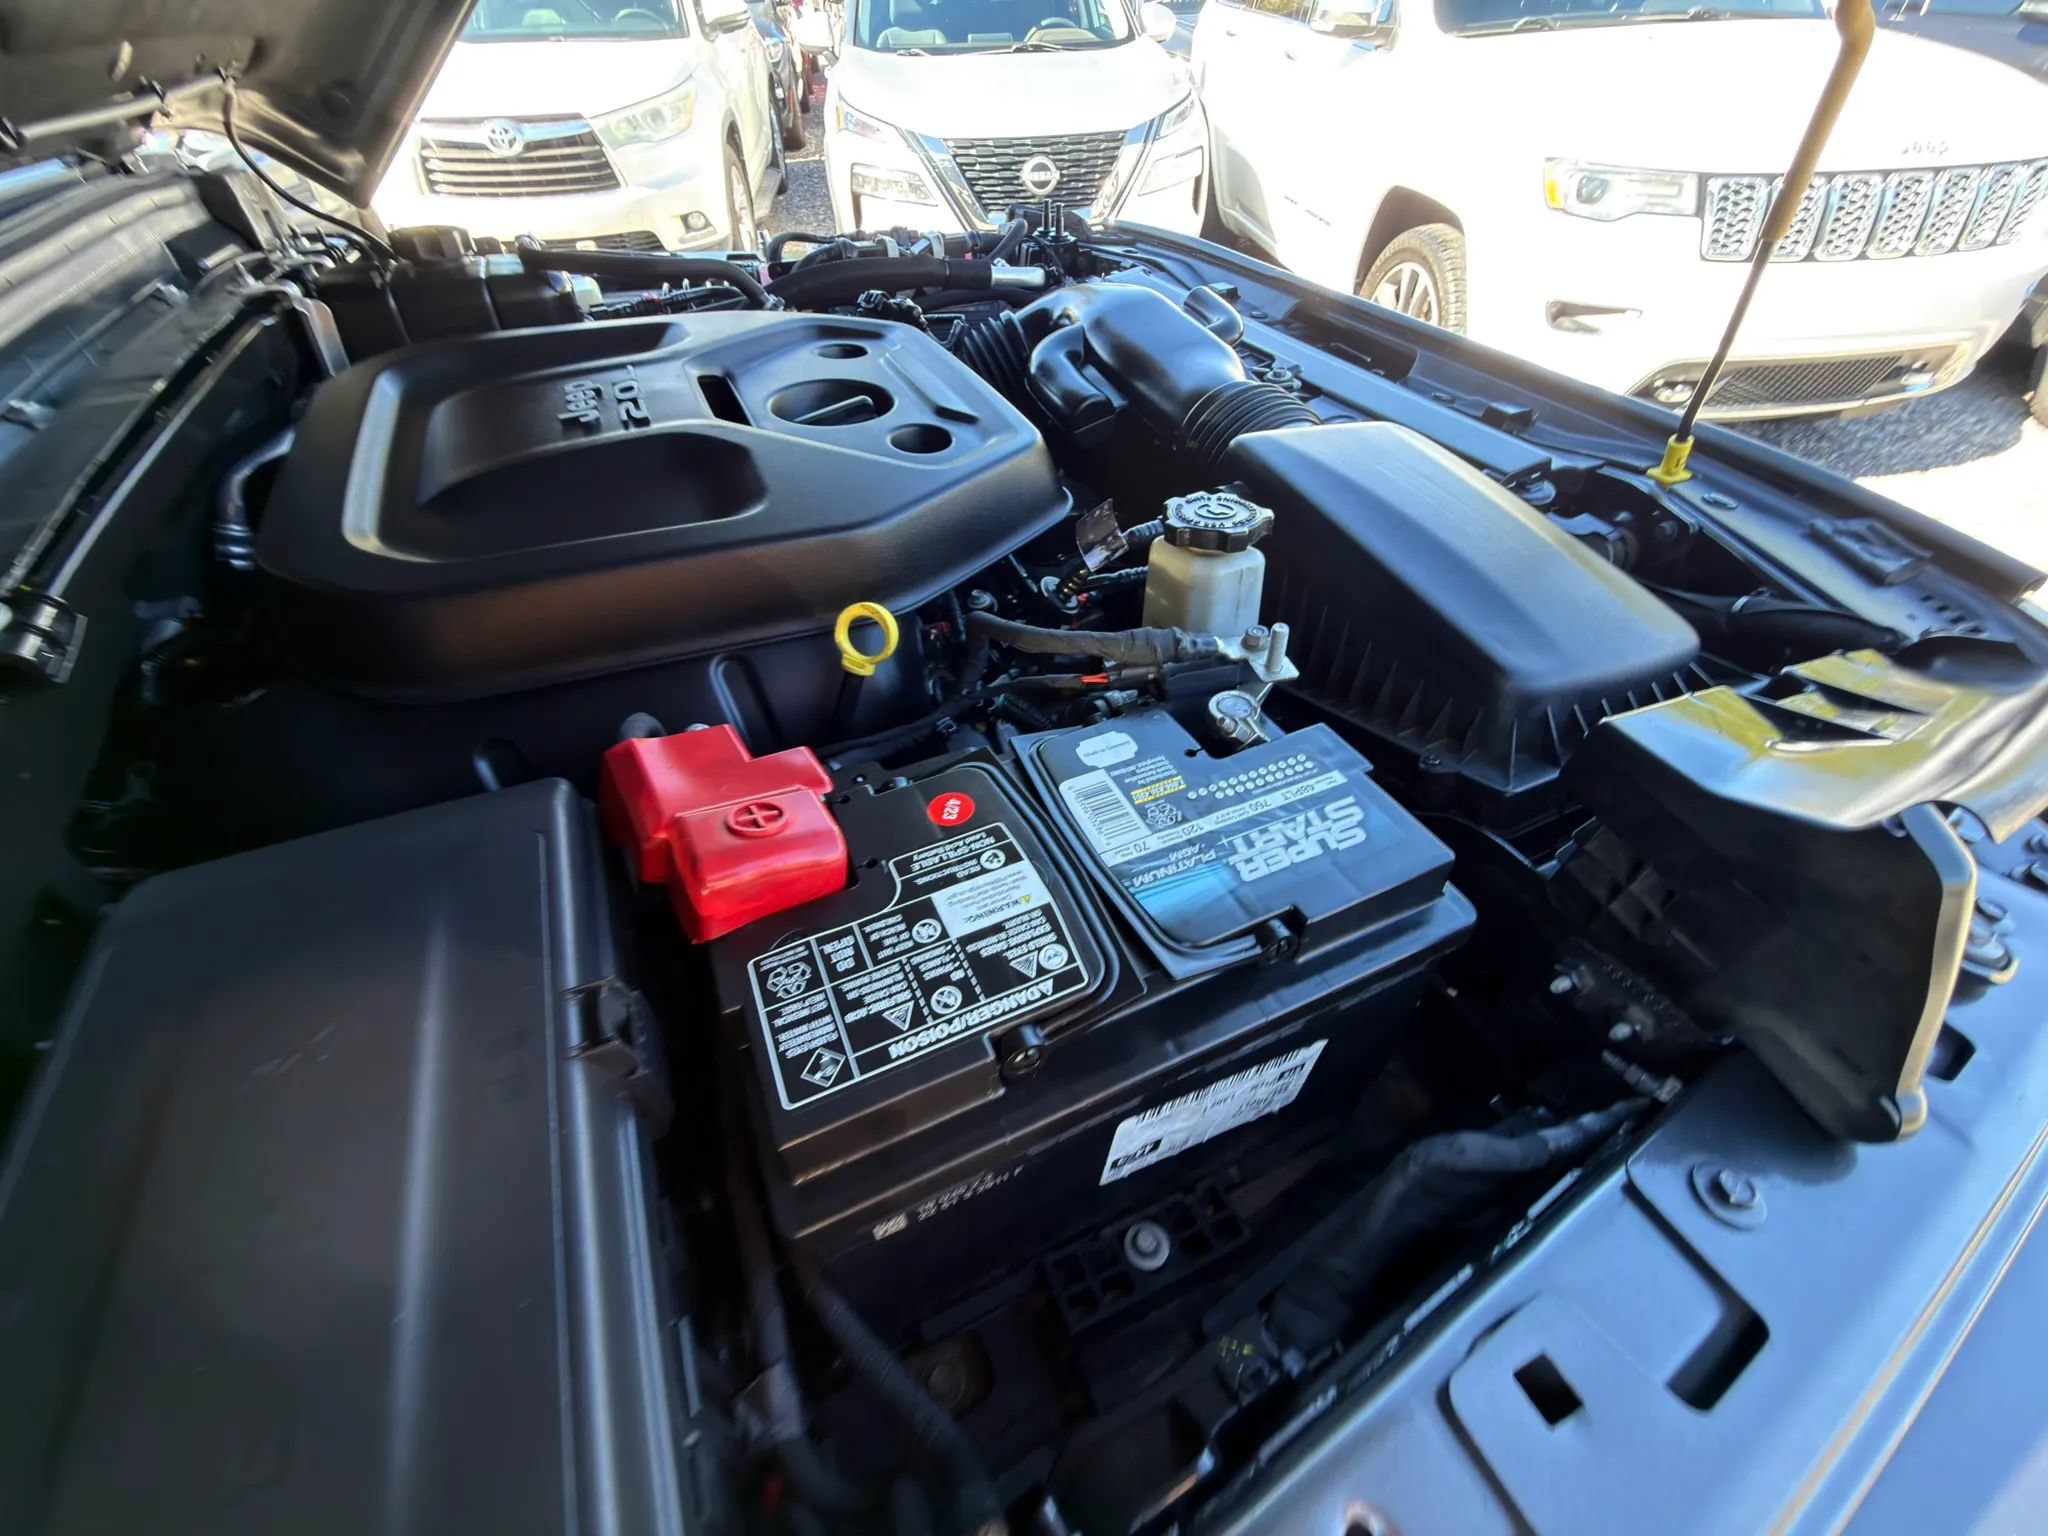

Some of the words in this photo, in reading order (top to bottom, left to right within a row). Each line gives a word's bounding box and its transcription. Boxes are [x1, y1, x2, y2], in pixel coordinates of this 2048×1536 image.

[557, 381, 603, 423] Jeep
[942, 798, 961, 820] 4/23
[1247, 798, 1272, 811] 760
[963, 830, 986, 843] Lead
[1180, 823, 1204, 835] 120
[1226, 796, 1366, 863] START
[942, 838, 964, 850] Acid
[1132, 841, 1150, 852] 70
[1237, 817, 1367, 883] SUPER
[909, 836, 995, 871] NON-SPILLABLE
[910, 846, 941, 861] Battery
[955, 864, 981, 877] READ
[1130, 849, 1218, 887] PLATINUM
[1005, 922, 1030, 936] CAUSE
[1028, 915, 1047, 927] CAN
[1006, 922, 1052, 946] EXPLOSIVE
[1026, 932, 1057, 950] SHIELD
[828, 946, 854, 962] NOT
[835, 957, 855, 971] DO
[866, 989, 912, 1013] SULFURIC
[843, 1006, 869, 1023] ACID
[887, 985, 1041, 1058] DANGER/POISON
